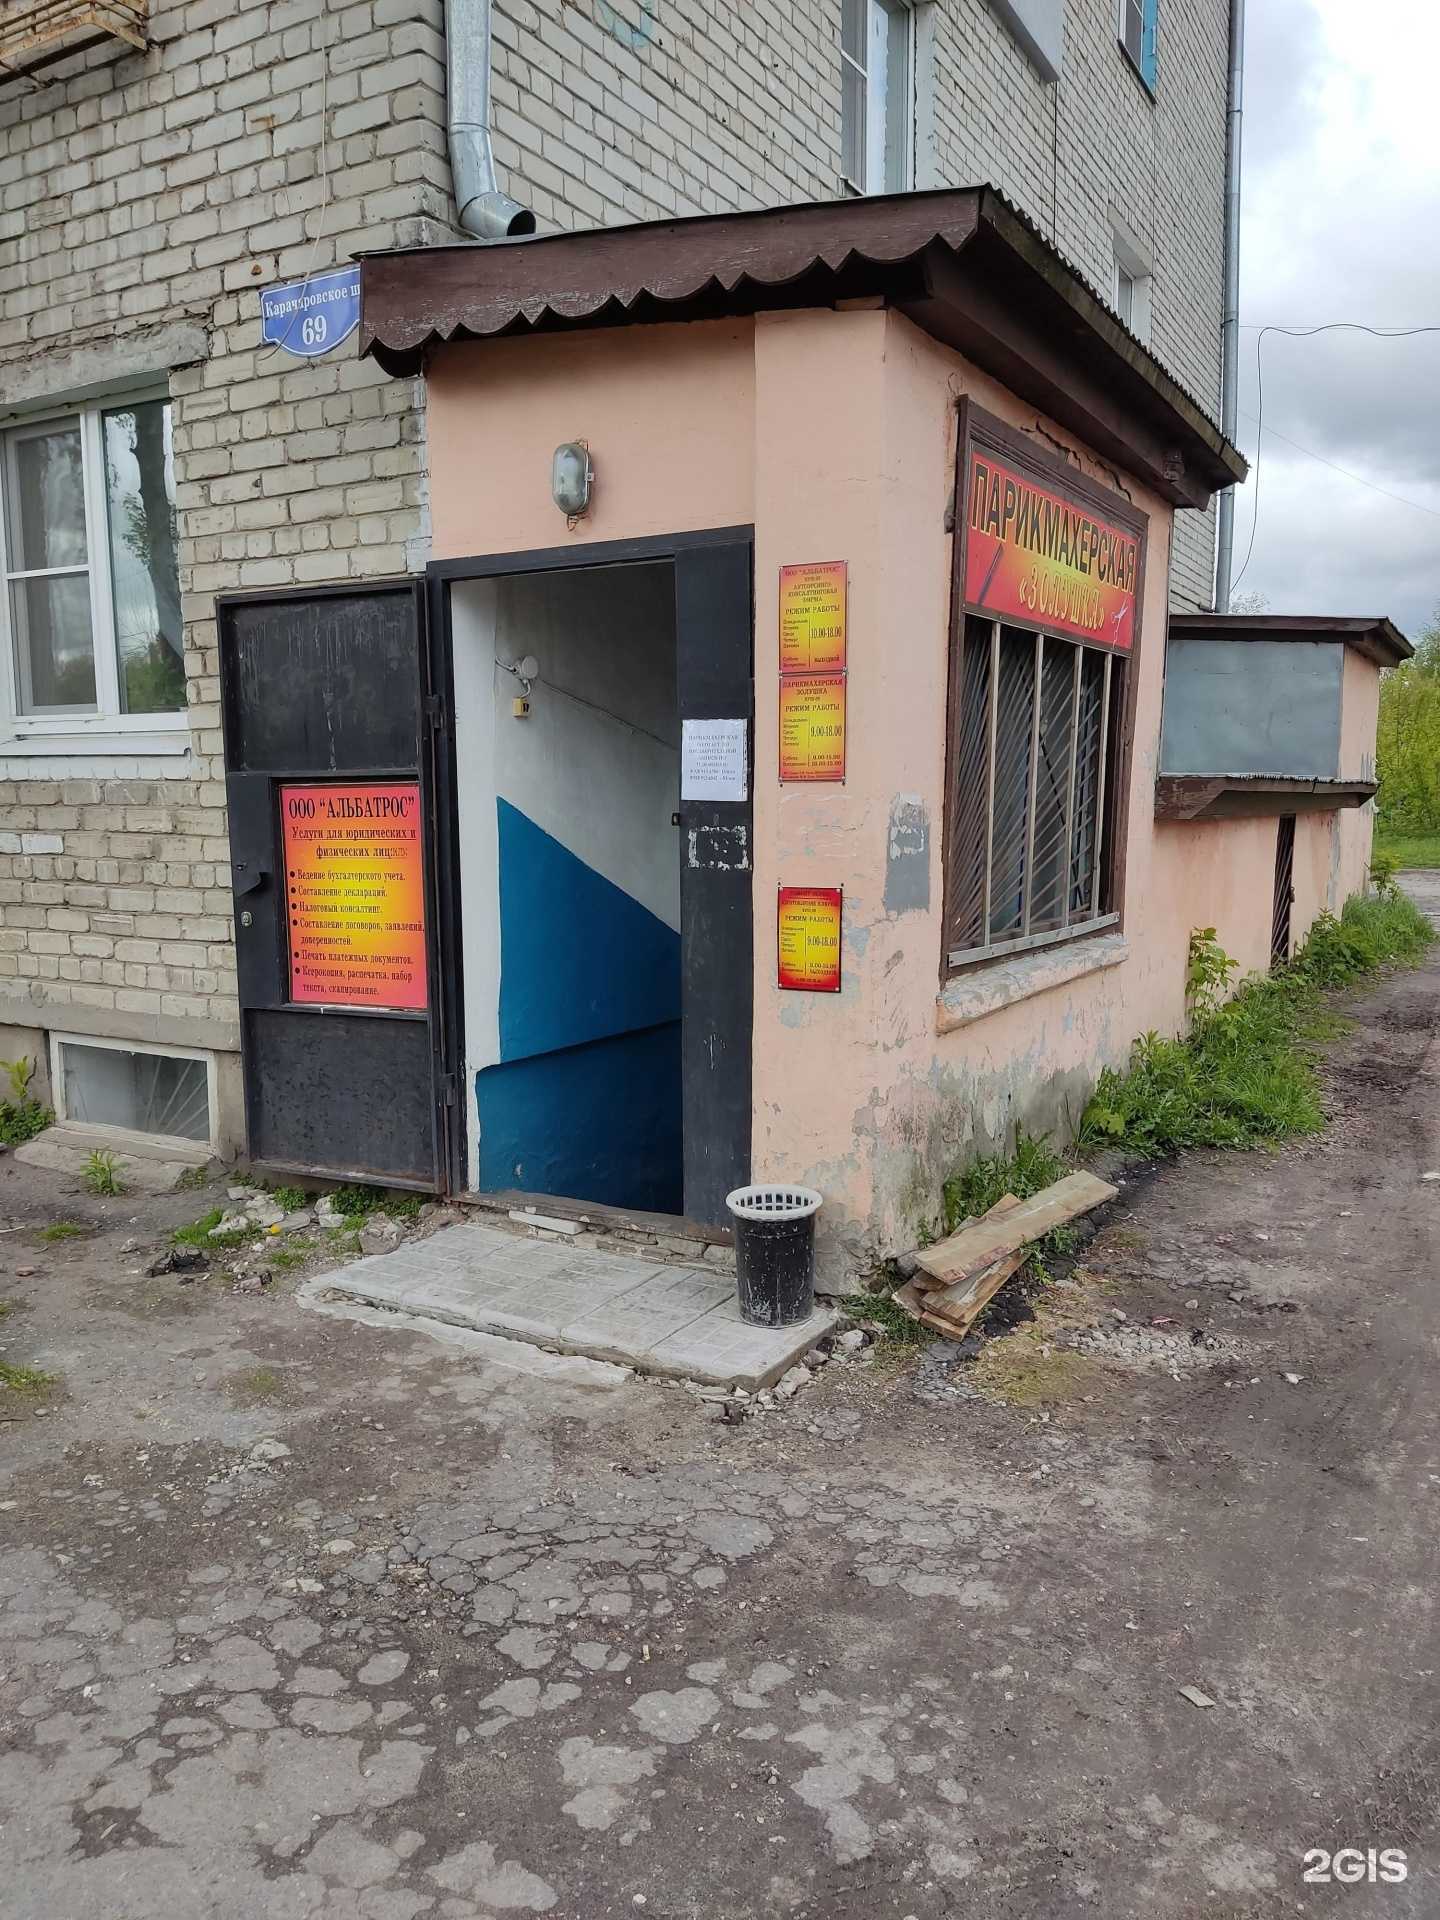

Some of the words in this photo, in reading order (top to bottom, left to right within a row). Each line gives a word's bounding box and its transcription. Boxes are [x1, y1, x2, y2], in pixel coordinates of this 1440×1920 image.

[302, 315, 327, 345] 69
[971, 463, 1136, 594] ПАРИКМАХЕРСКАЯ
[785, 607, 810, 615] РЕЖИМ
[813, 604, 840, 613] РАБОТЫ
[811, 627, 842, 639] 10.00-18.00
[785, 705, 810, 713] РЕЖИМ
[812, 703, 840, 711] РАБОТЫ
[288, 797, 316, 819] ООО
[292, 826, 324, 841] Услуги
[326, 829, 343, 840] для
[345, 829, 407, 841] юридических
[410, 829, 417, 839] и
[316, 845, 370, 860] физических
[297, 869, 326, 880] Ведение
[327, 869, 382, 884] бухгалтерского
[298, 885, 342, 898] Составление
[299, 901, 338, 913] Налоговый
[300, 917, 344, 929] Составление
[301, 950, 327, 961] Печать
[328, 954, 369, 964] платежных
[391, 969, 413, 984] набор
